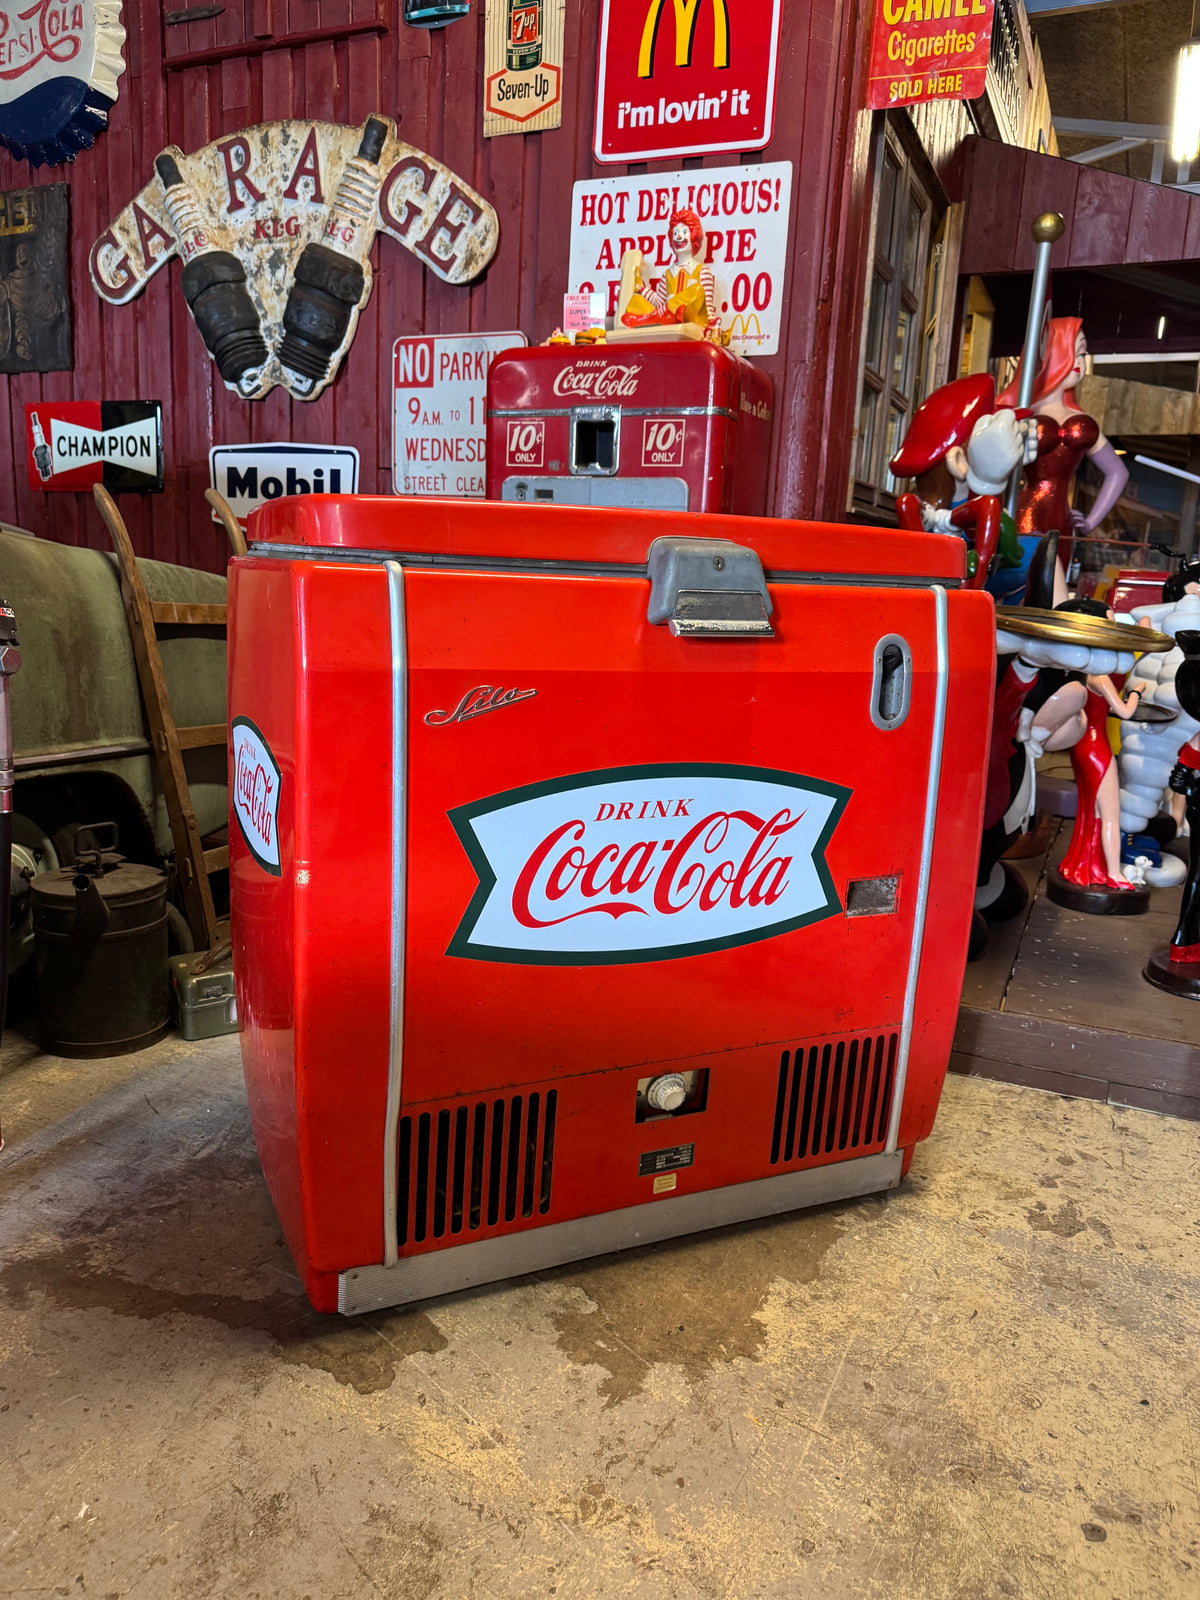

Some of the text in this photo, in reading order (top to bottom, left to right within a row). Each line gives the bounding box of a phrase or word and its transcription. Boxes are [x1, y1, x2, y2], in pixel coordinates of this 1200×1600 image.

[887, 29, 976, 66] Cigarettes
[497, 73, 549, 102] Seven-Up
[889, 74, 963, 99] SOLD HERE
[617, 89, 751, 129] i'm lovin' it
[89, 126, 484, 300] GARAGE
[580, 177, 782, 227] HOT DELICIOUS!
[595, 228, 757, 270] APPL PIE
[400, 343, 430, 382] NO
[553, 365, 643, 397] Coca-Cola
[408, 397, 421, 424] 9
[422, 411, 444, 426] A.M.
[450, 410, 461, 421] TO
[57, 435, 151, 457] CHAMPION
[405, 438, 487, 462] WEDNESD
[515, 453, 537, 463] ONLY
[651, 452, 675, 463] ONLY
[226, 467, 341, 500] Mobil
[404, 476, 484, 491] STREET CLEA
[237, 744, 274, 847] Coca-Cola
[593, 798, 695, 822] DRINK
[511, 806, 809, 928] Coca-Cola
